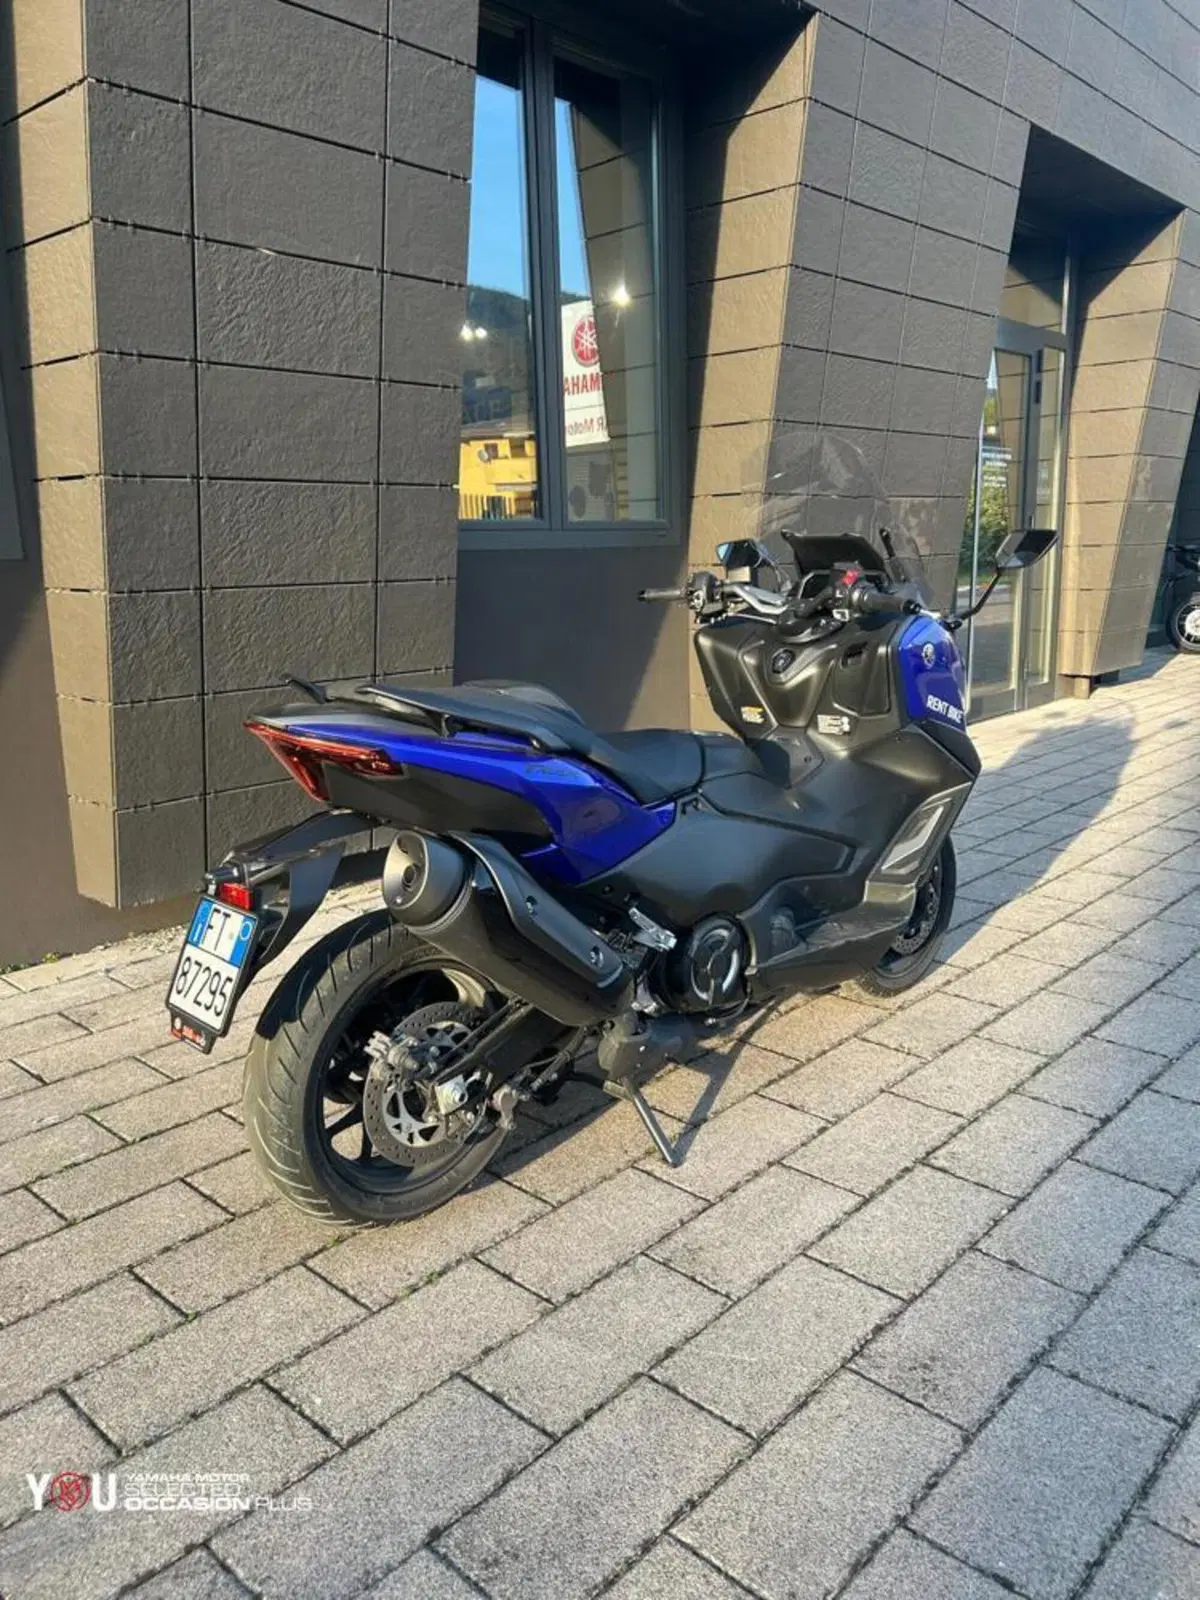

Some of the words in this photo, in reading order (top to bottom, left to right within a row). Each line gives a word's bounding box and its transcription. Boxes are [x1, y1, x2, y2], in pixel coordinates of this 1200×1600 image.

[926, 694, 950, 716] RENT
[202, 907, 231, 951] FT
[175, 956, 233, 1017] 87295
